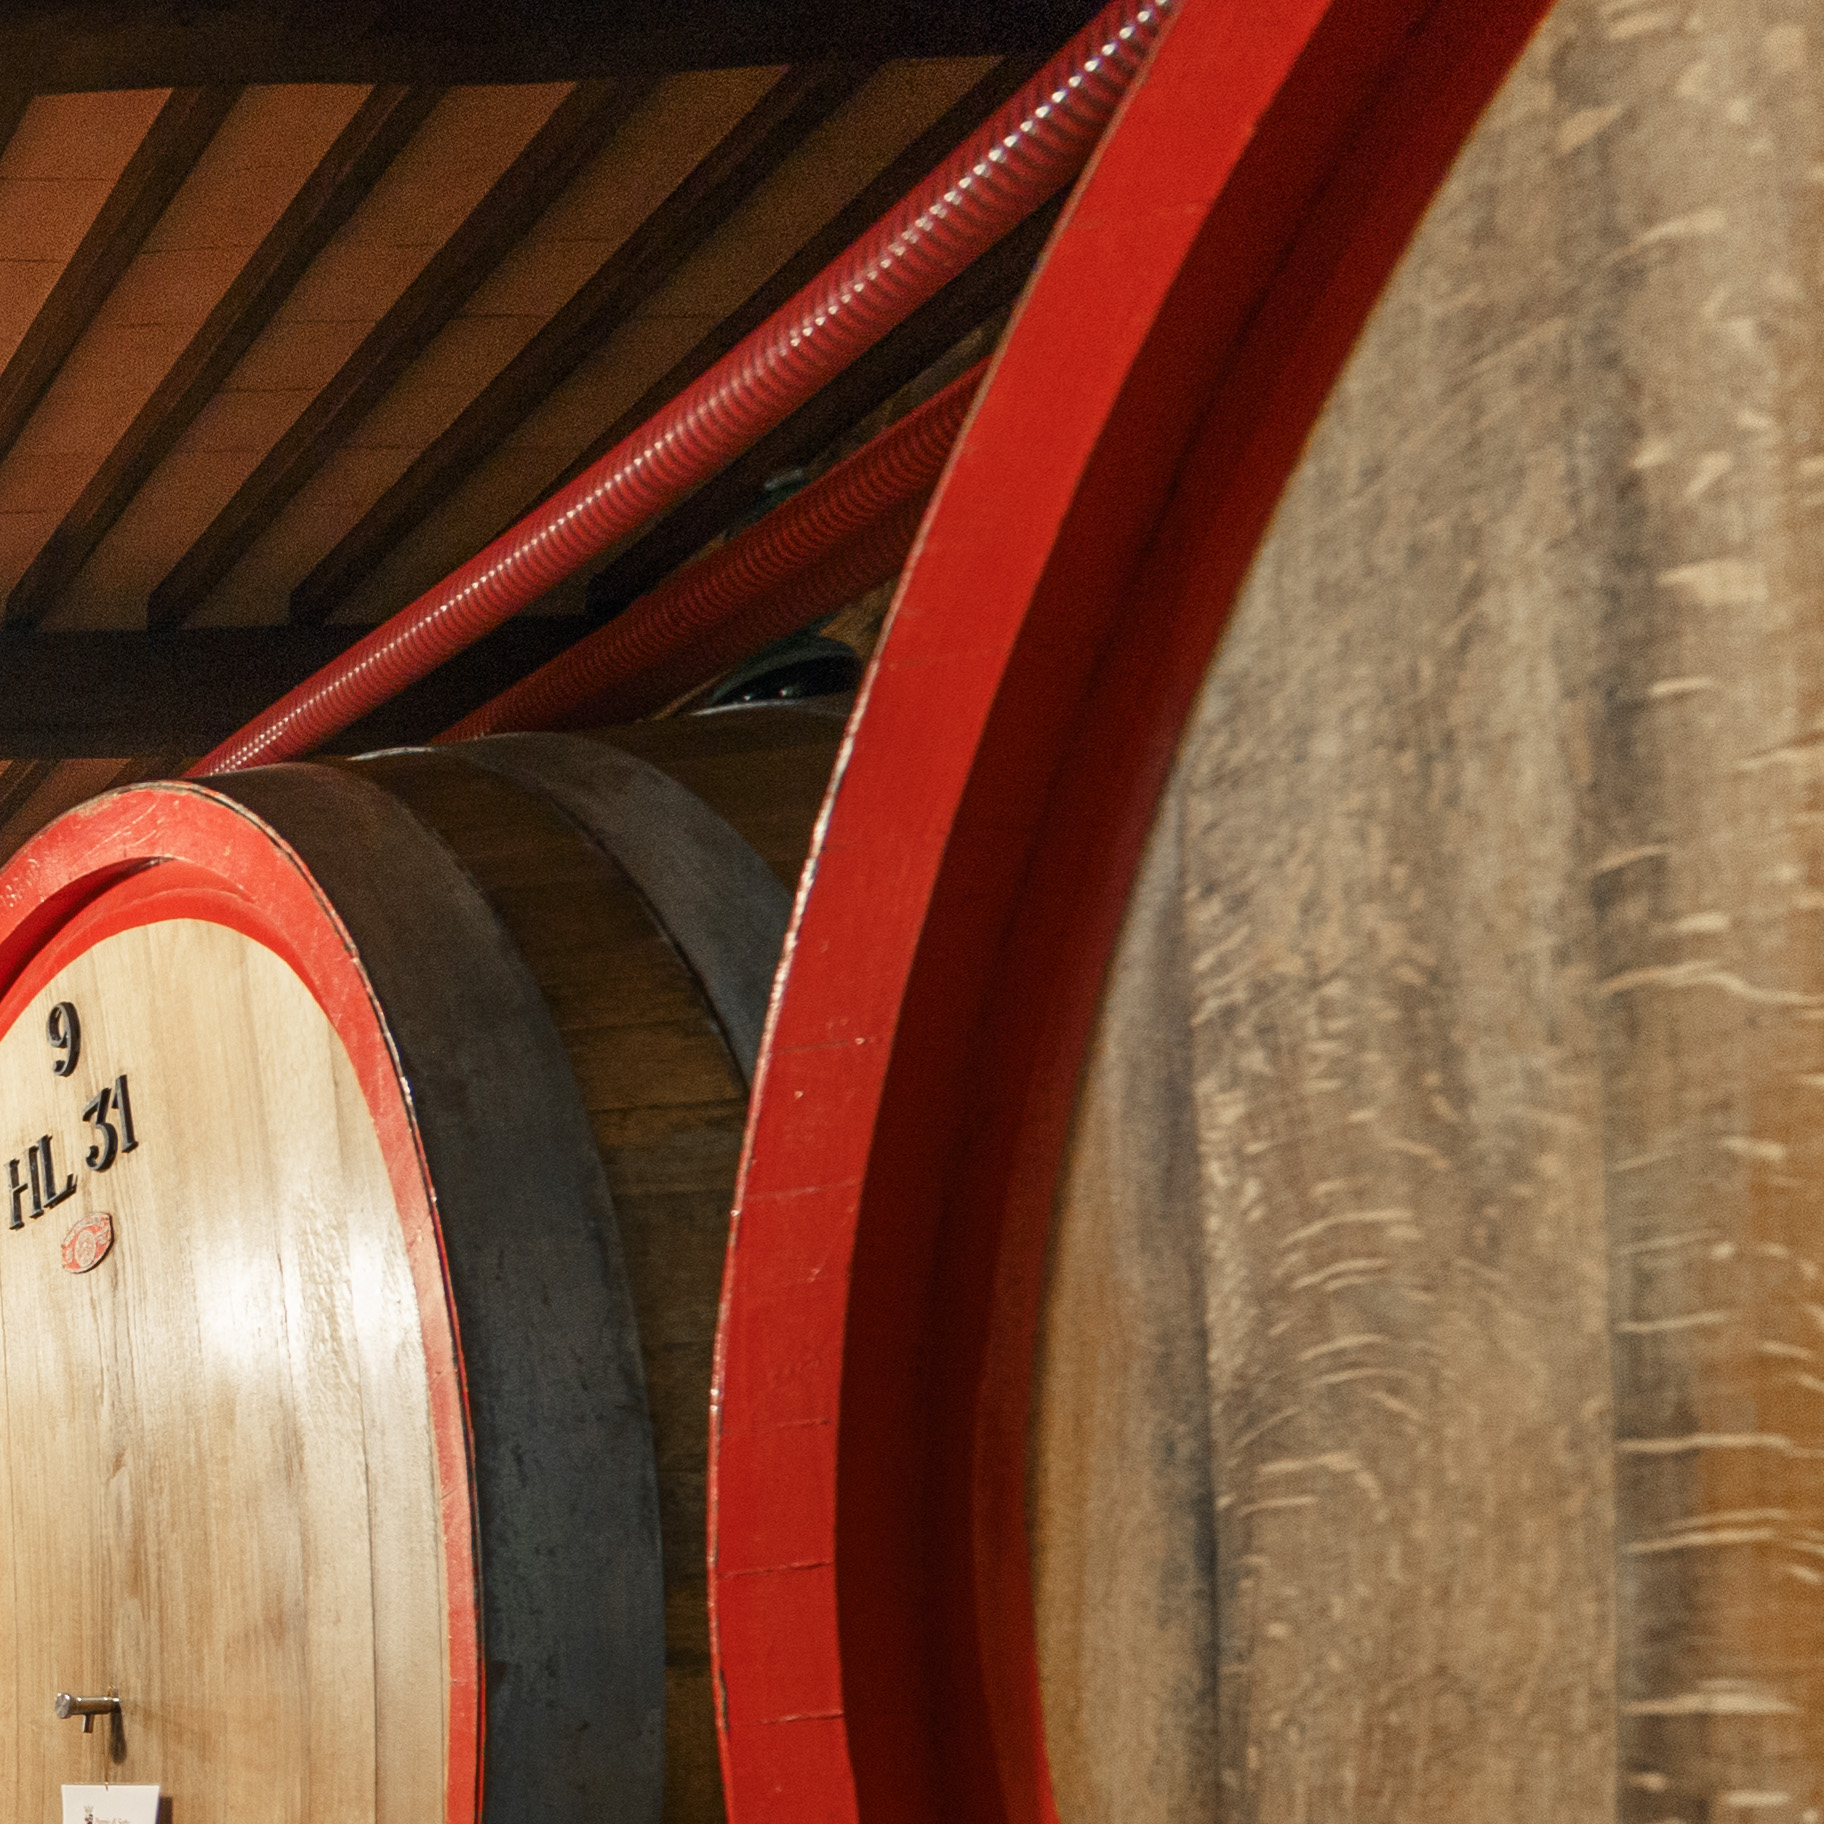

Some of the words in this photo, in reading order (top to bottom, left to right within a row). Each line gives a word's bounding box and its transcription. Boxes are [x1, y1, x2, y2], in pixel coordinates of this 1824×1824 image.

[46, 1001, 82, 1077] 9
[4, 1134, 79, 1231] HL
[82, 1074, 139, 1173] 31
